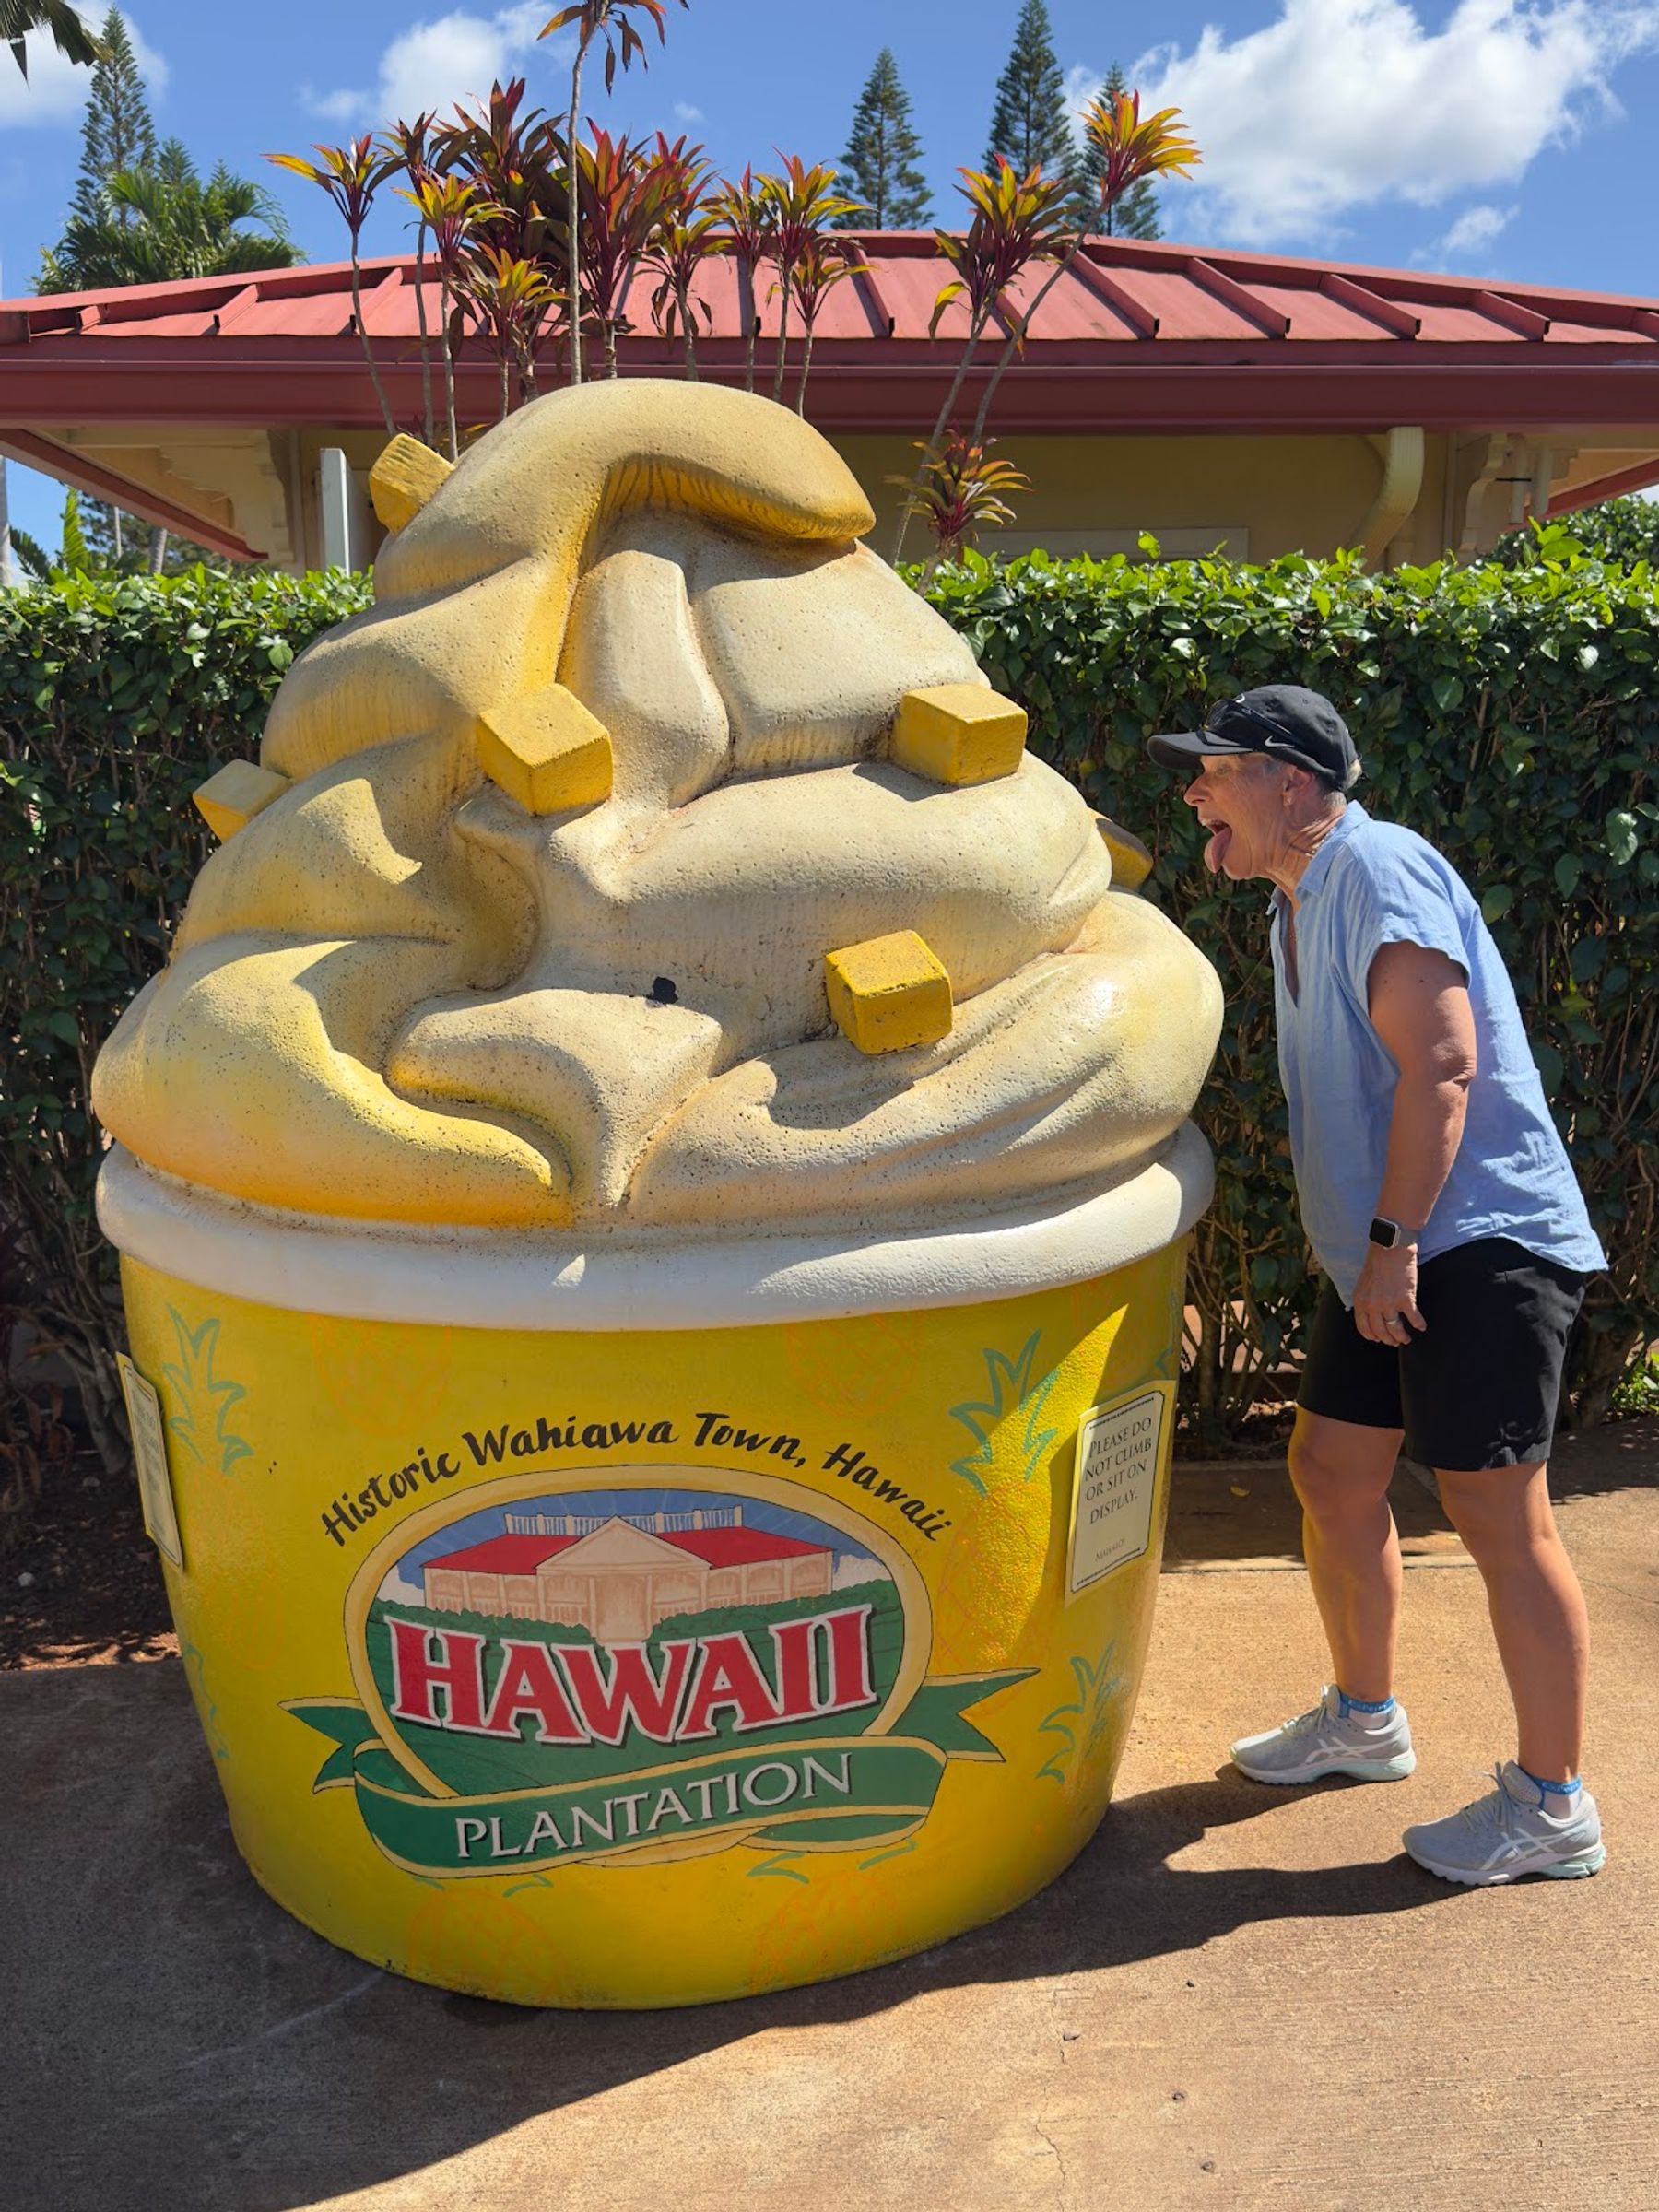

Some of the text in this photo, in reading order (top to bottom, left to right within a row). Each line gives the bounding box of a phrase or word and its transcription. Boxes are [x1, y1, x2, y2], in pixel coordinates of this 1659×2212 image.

[1089, 1417, 1152, 1458] PLEASE DO
[321, 1412, 952, 1547] Historic Wahiawa Town, Hawaii
[1085, 1438, 1152, 1482] NOT CLIMB
[1086, 1458, 1147, 1502] OR SIT ON
[1089, 1488, 1138, 1524] DISPLAY.
[383, 1603, 877, 1746] HAWAII
[455, 1753, 853, 1858] PLANTATION
